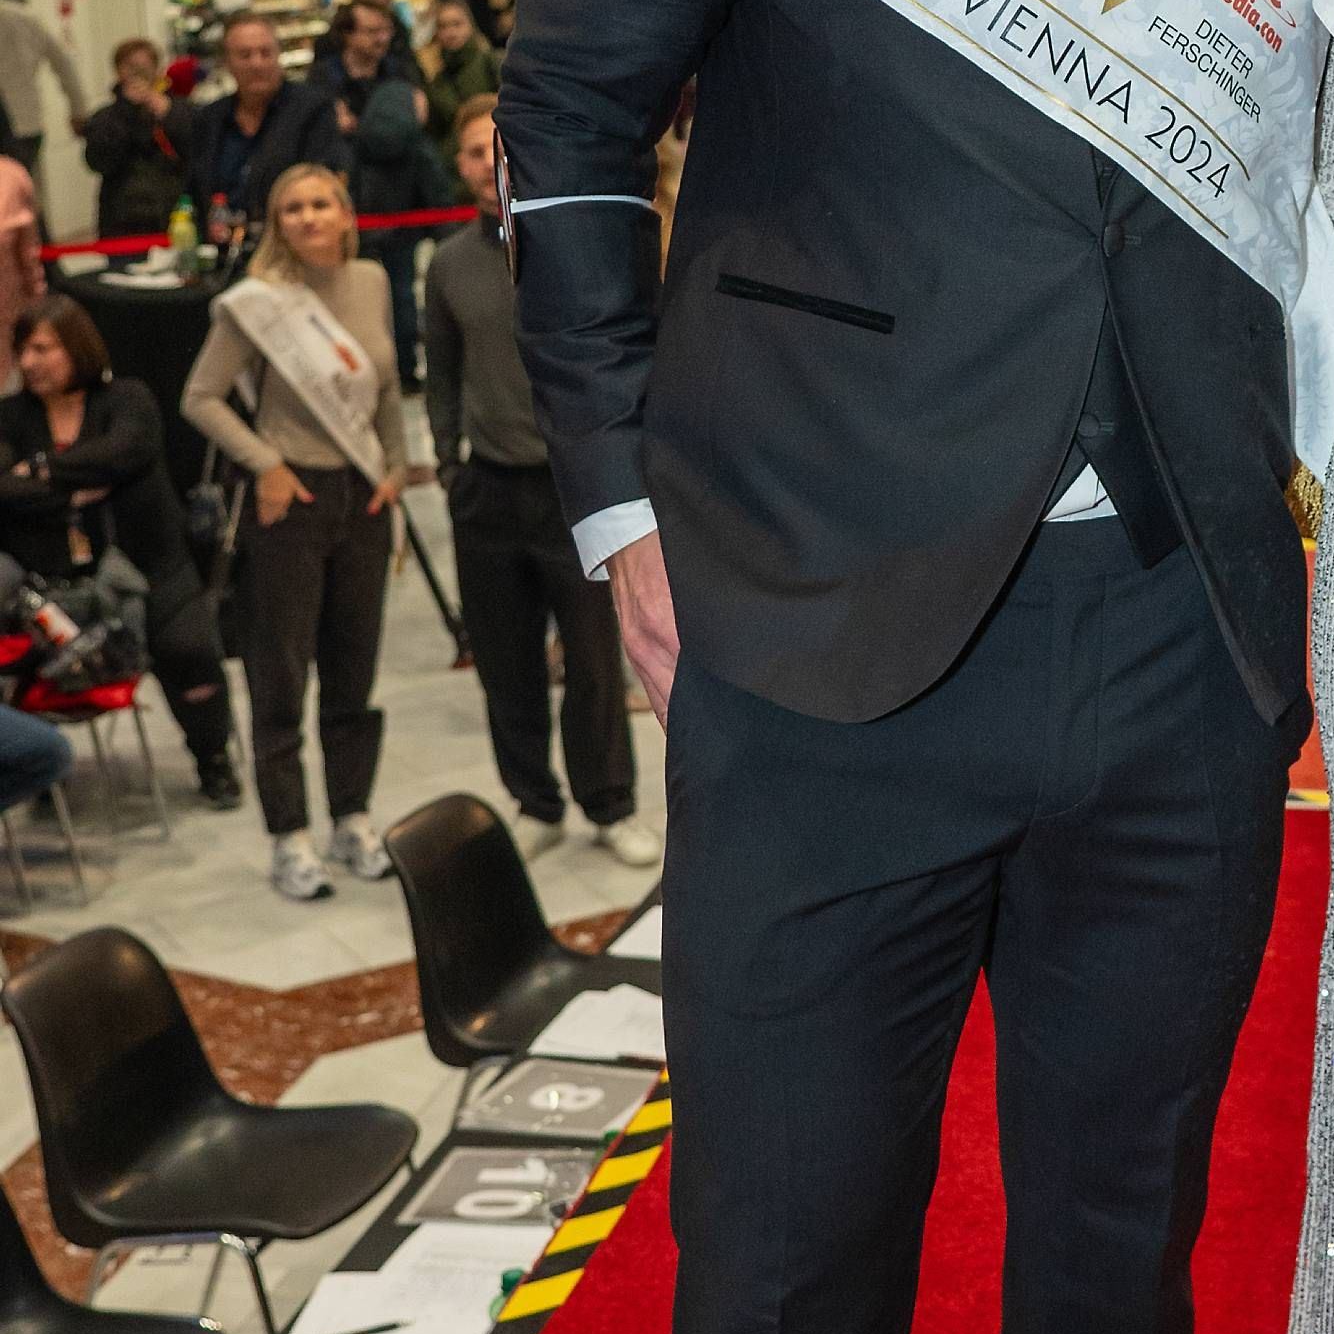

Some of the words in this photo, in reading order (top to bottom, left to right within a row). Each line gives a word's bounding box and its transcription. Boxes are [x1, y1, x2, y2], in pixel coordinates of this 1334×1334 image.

[1148, 15, 1261, 124] FERSCHINGER
[1195, 18, 1254, 80] DIETER
[1144, 105, 1232, 199] 2024
[528, 1081, 605, 1112] 8
[453, 1155, 557, 1218] 10
